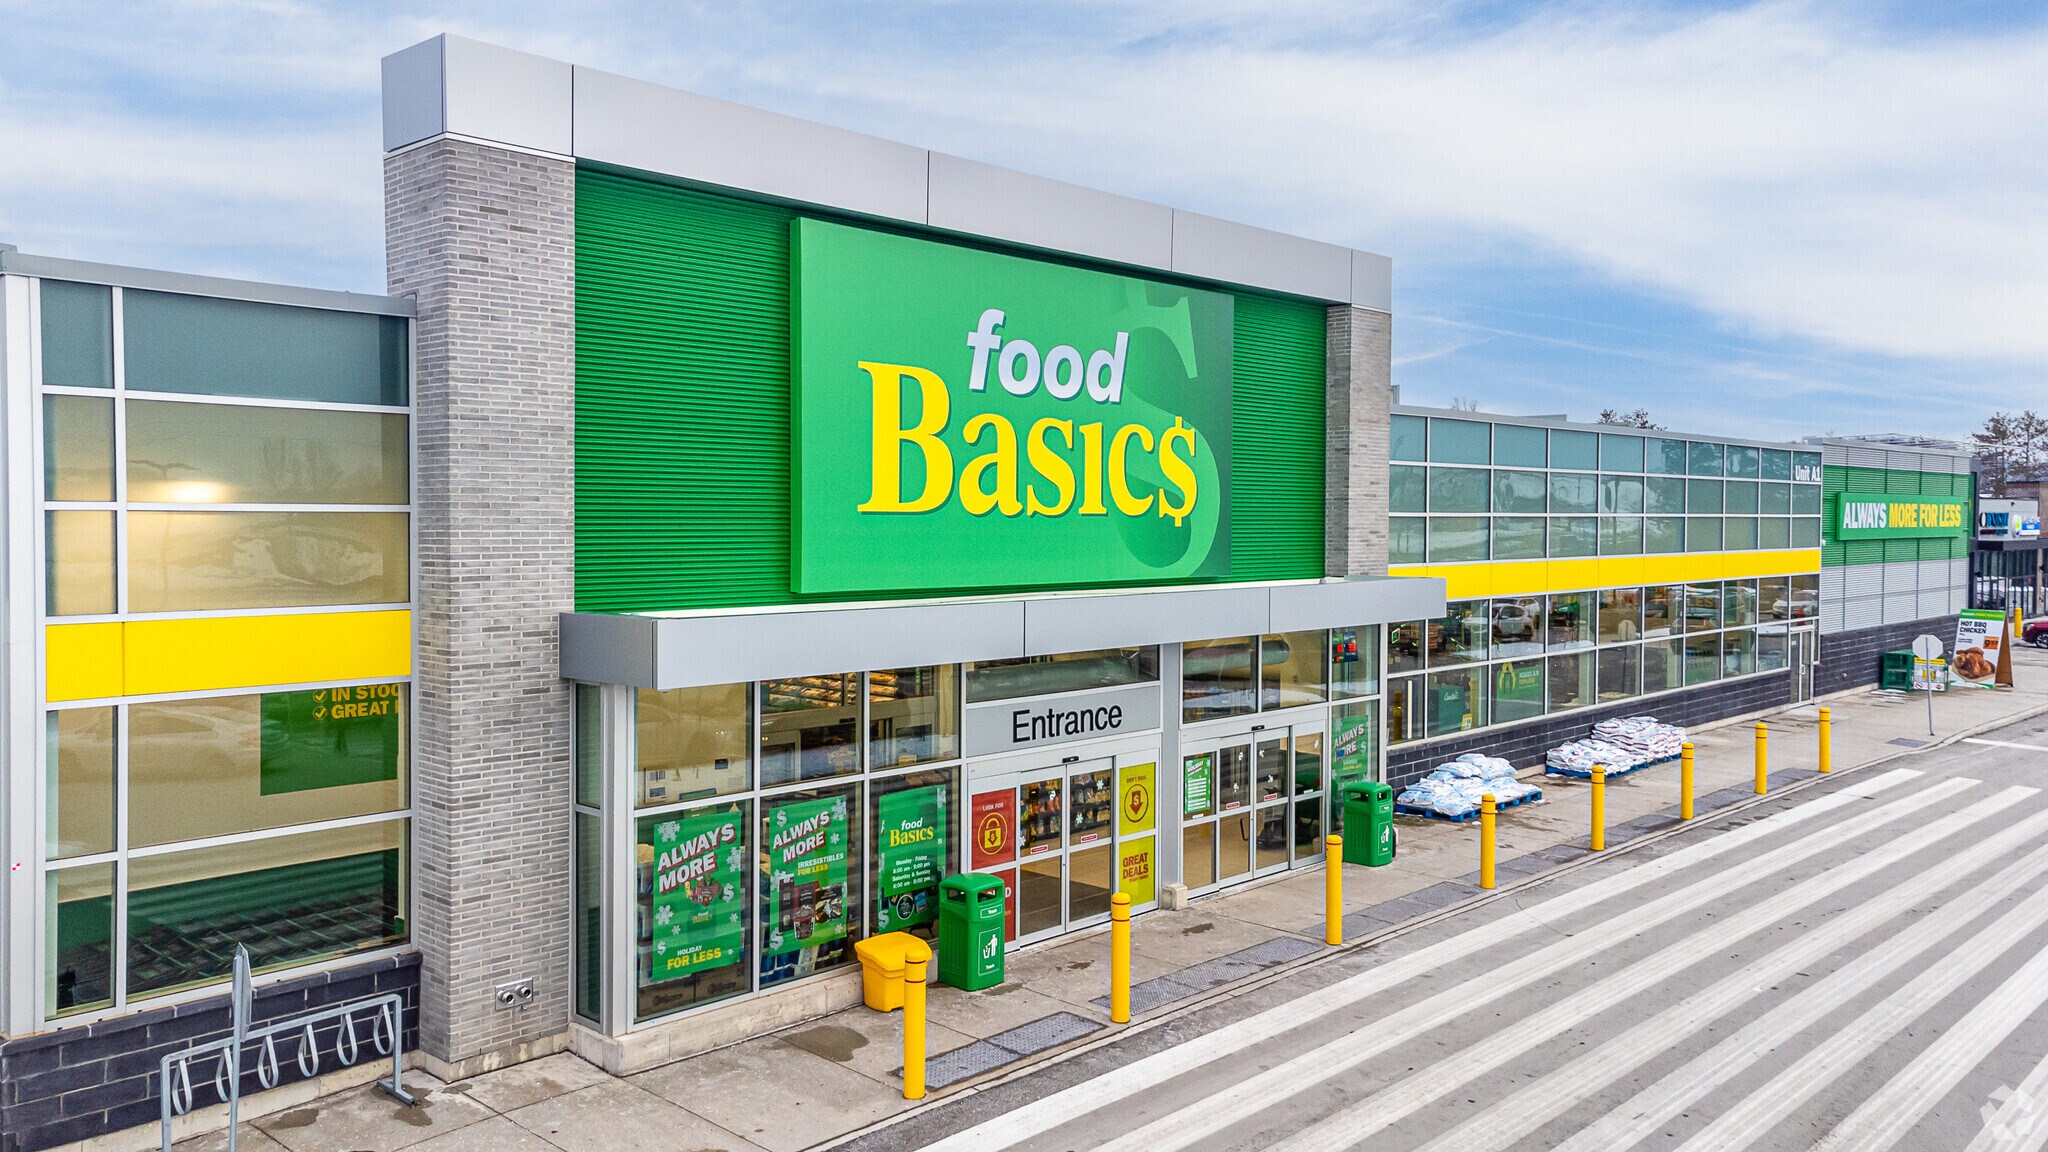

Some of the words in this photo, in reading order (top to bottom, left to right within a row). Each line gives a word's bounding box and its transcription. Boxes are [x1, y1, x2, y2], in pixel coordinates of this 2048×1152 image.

[966, 308, 1130, 403] food
[1795, 465, 1810, 482] Unit
[1811, 465, 1821, 482] A1
[1843, 502, 1887, 529] ALWAYS
[1889, 503, 1918, 528] MORE
[1919, 503, 1938, 528] FOR
[1939, 504, 1962, 527] LESS
[1974, 621, 1987, 629] BBQ
[331, 687, 350, 702] IN
[331, 701, 389, 719] GREAT
[1012, 704, 1123, 743] Entrance
[1334, 724, 1365, 748] ALWAYS
[773, 811, 831, 850] ALWAYS
[901, 817, 923, 831] food
[657, 823, 736, 873] ALWAYS
[783, 831, 827, 864] MORE
[797, 852, 844, 869] IRRESISTIBLES
[1122, 852, 1149, 868] GREAT
[659, 852, 718, 894] MORE
[797, 868, 811, 876] FOR
[812, 863, 829, 873] LESS
[1122, 863, 1149, 879] DEALS
[667, 955, 690, 970] FOR
[692, 947, 722, 964] LESS
[677, 945, 703, 956] HOLIDAY
